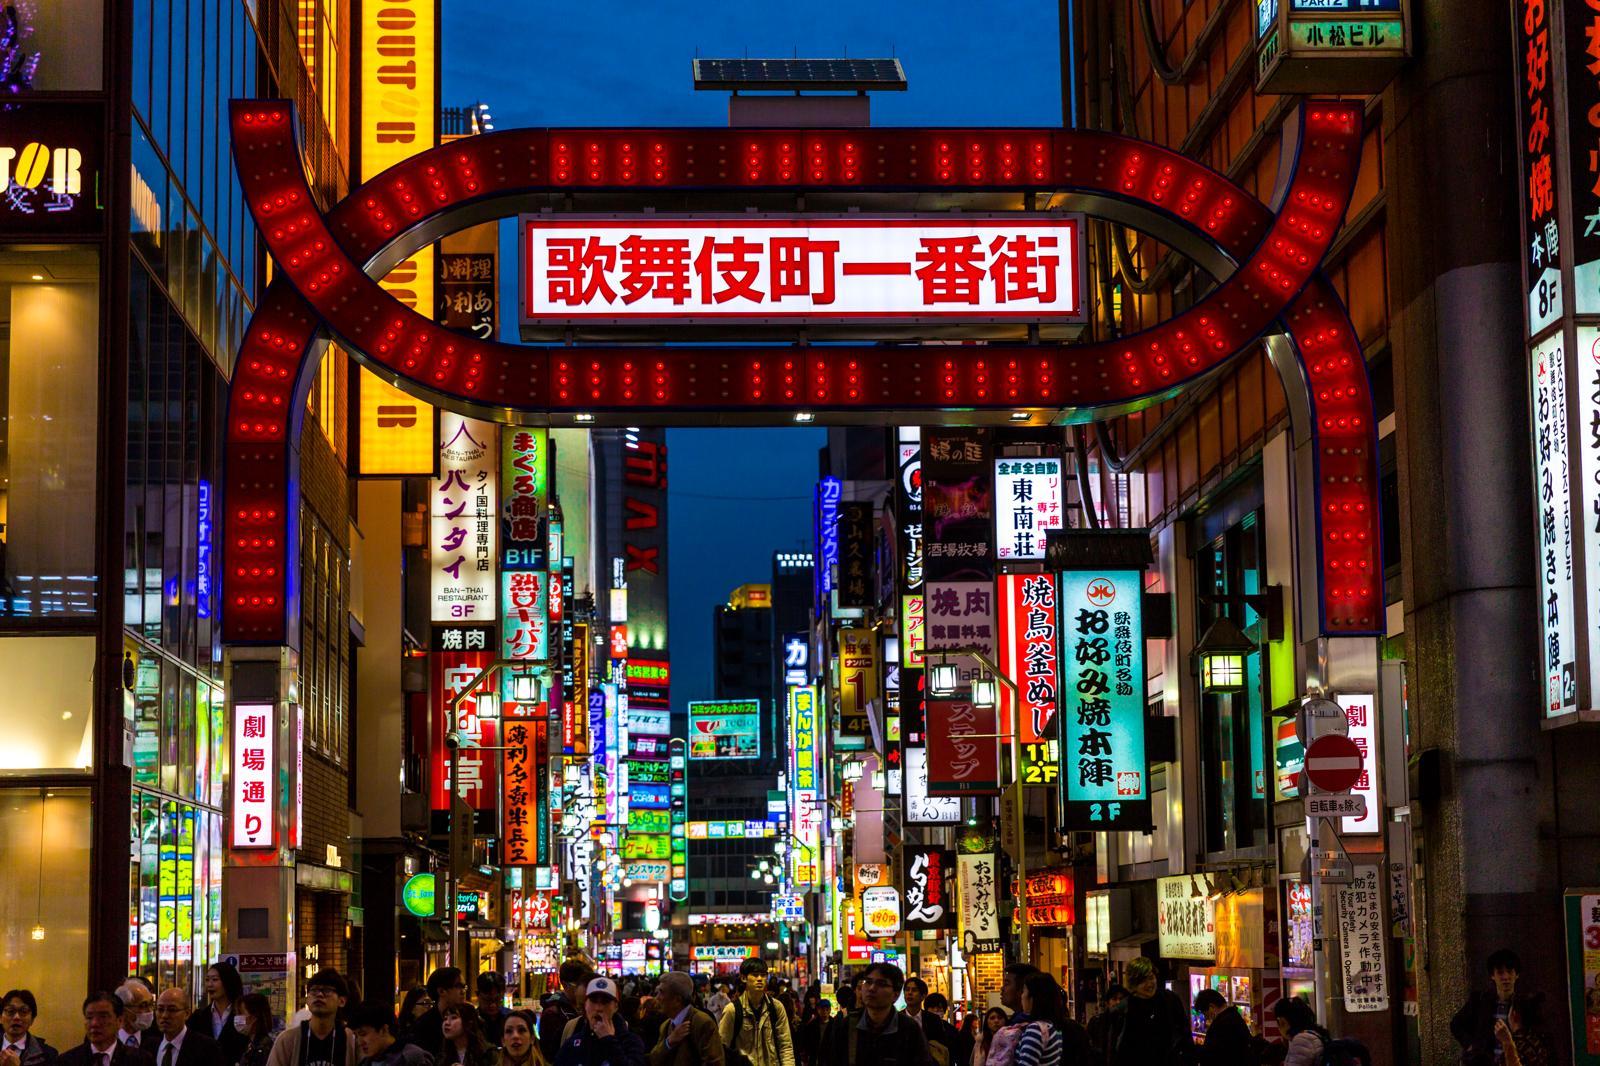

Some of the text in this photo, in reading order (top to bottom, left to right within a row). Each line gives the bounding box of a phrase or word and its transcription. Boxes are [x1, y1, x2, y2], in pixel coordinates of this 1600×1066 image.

[1307, 25, 1385, 46] 小松ビル
[376, 0, 420, 144] OUTOR
[546, 235, 1060, 305] 歌舞伎町一番街
[1538, 279, 1557, 319] 8F
[998, 462, 1059, 475] 全卓全自動
[439, 469, 471, 580] バンタイ
[476, 470, 490, 572] タイ国料理専門店
[1012, 477, 1035, 557] 東南荘
[505, 549, 543, 565] B1F
[1000, 547, 1011, 557] 3F
[438, 594, 488, 602] RESTAURANT
[451, 604, 475, 618] 3F
[931, 587, 991, 617] 焼肉
[442, 629, 486, 650] 焼肉
[1114, 611, 1133, 696] 歌舞伎町名物
[513, 705, 537, 717] 4F
[846, 670, 865, 712] 1
[1075, 608, 1114, 788] お好み焼本陣
[947, 703, 980, 780] ステップ
[242, 715, 266, 836] 劇場通り
[1026, 765, 1058, 783] 2F
[1089, 803, 1121, 822] 2F
[1309, 800, 1361, 813] 自転車を除く
[972, 860, 996, 932] お好み焼き
[981, 942, 1000, 951] B1F
[1354, 877, 1373, 987] 防犯カメラ作動中
[1366, 870, 1383, 992] みなさまの安全を守ります
